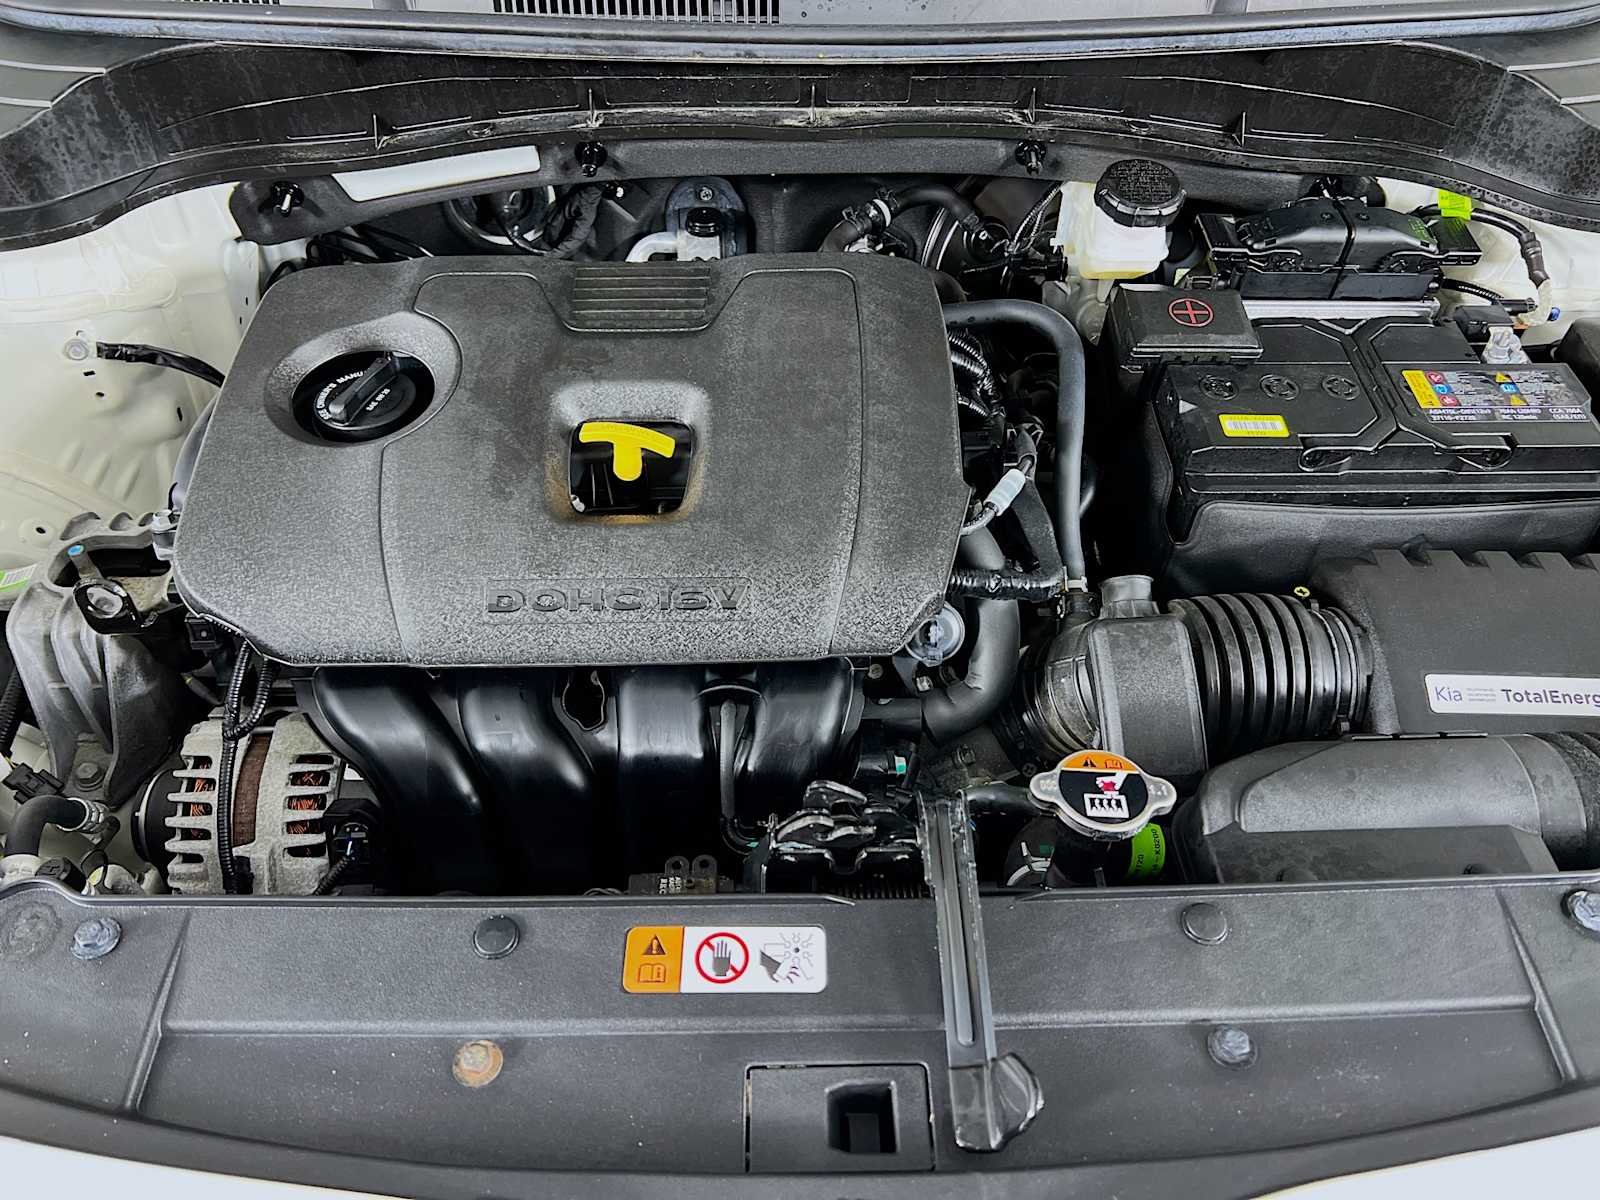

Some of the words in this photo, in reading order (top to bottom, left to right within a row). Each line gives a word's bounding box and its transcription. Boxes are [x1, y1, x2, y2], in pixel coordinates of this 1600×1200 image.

[487, 588, 643, 612] DOHC
[657, 585, 750, 612] 16V
[1434, 686, 1463, 702] Kia
